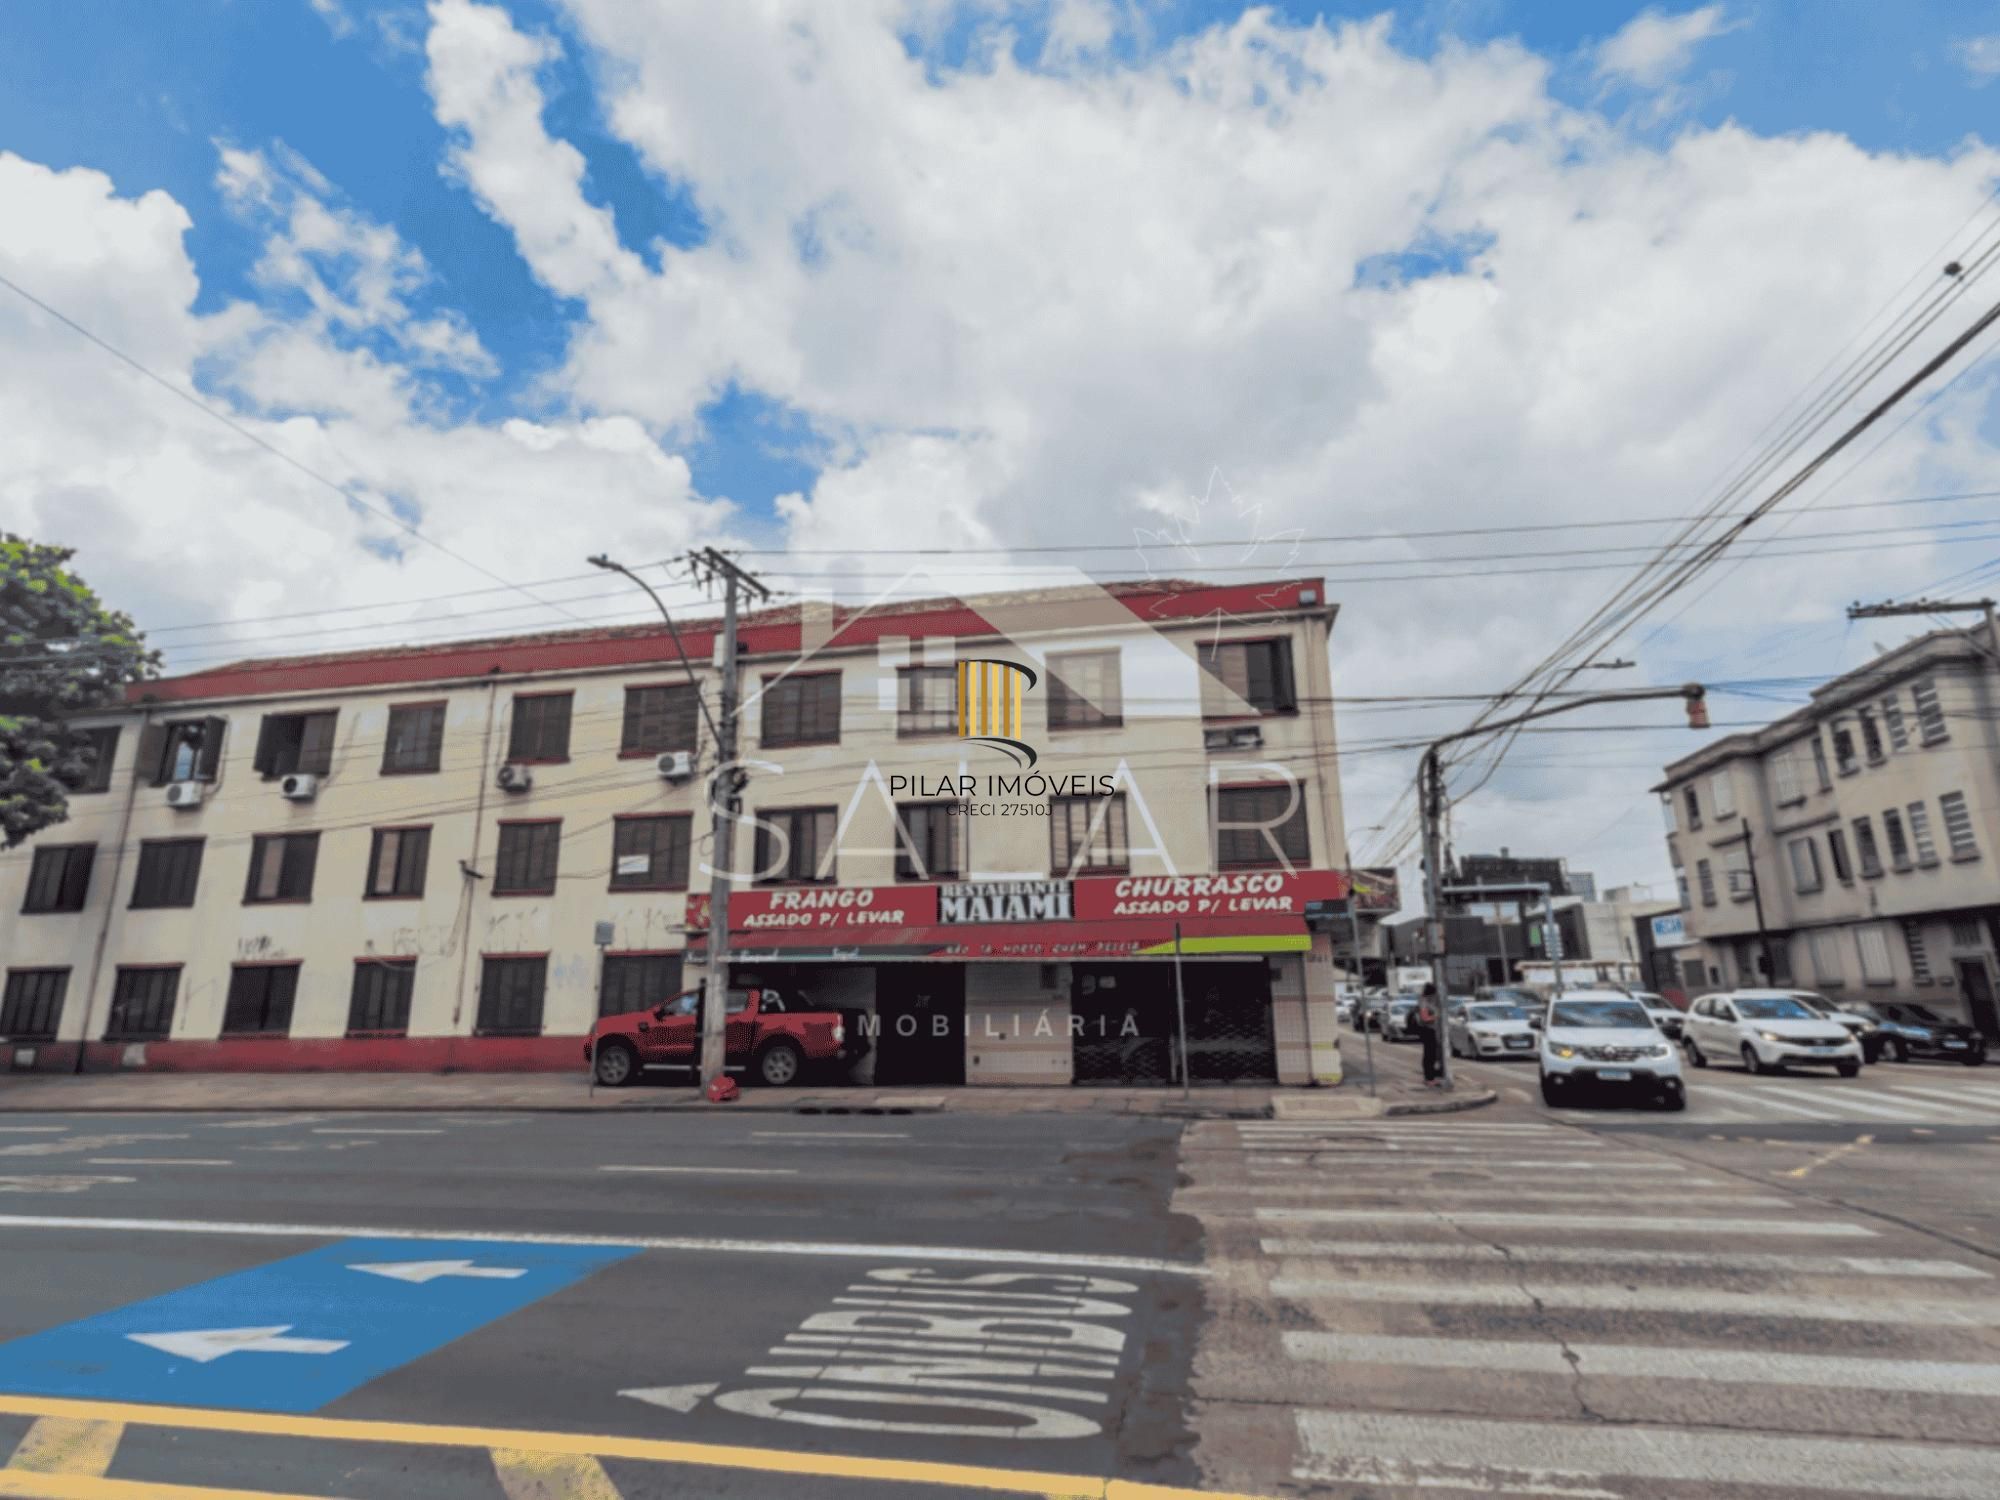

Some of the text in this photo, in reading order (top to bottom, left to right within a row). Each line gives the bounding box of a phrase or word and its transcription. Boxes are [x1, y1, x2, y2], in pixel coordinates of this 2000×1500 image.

[941, 880, 1070, 896] RESTAURANTE
[1114, 874, 1284, 898] CHURRASCO
[769, 888, 874, 910] FRANGO
[941, 893, 1073, 922] MAIAMI
[1113, 896, 1293, 915] ASSADO P/ LEVAR
[743, 910, 905, 927] ASSADO P/ LEVAR
